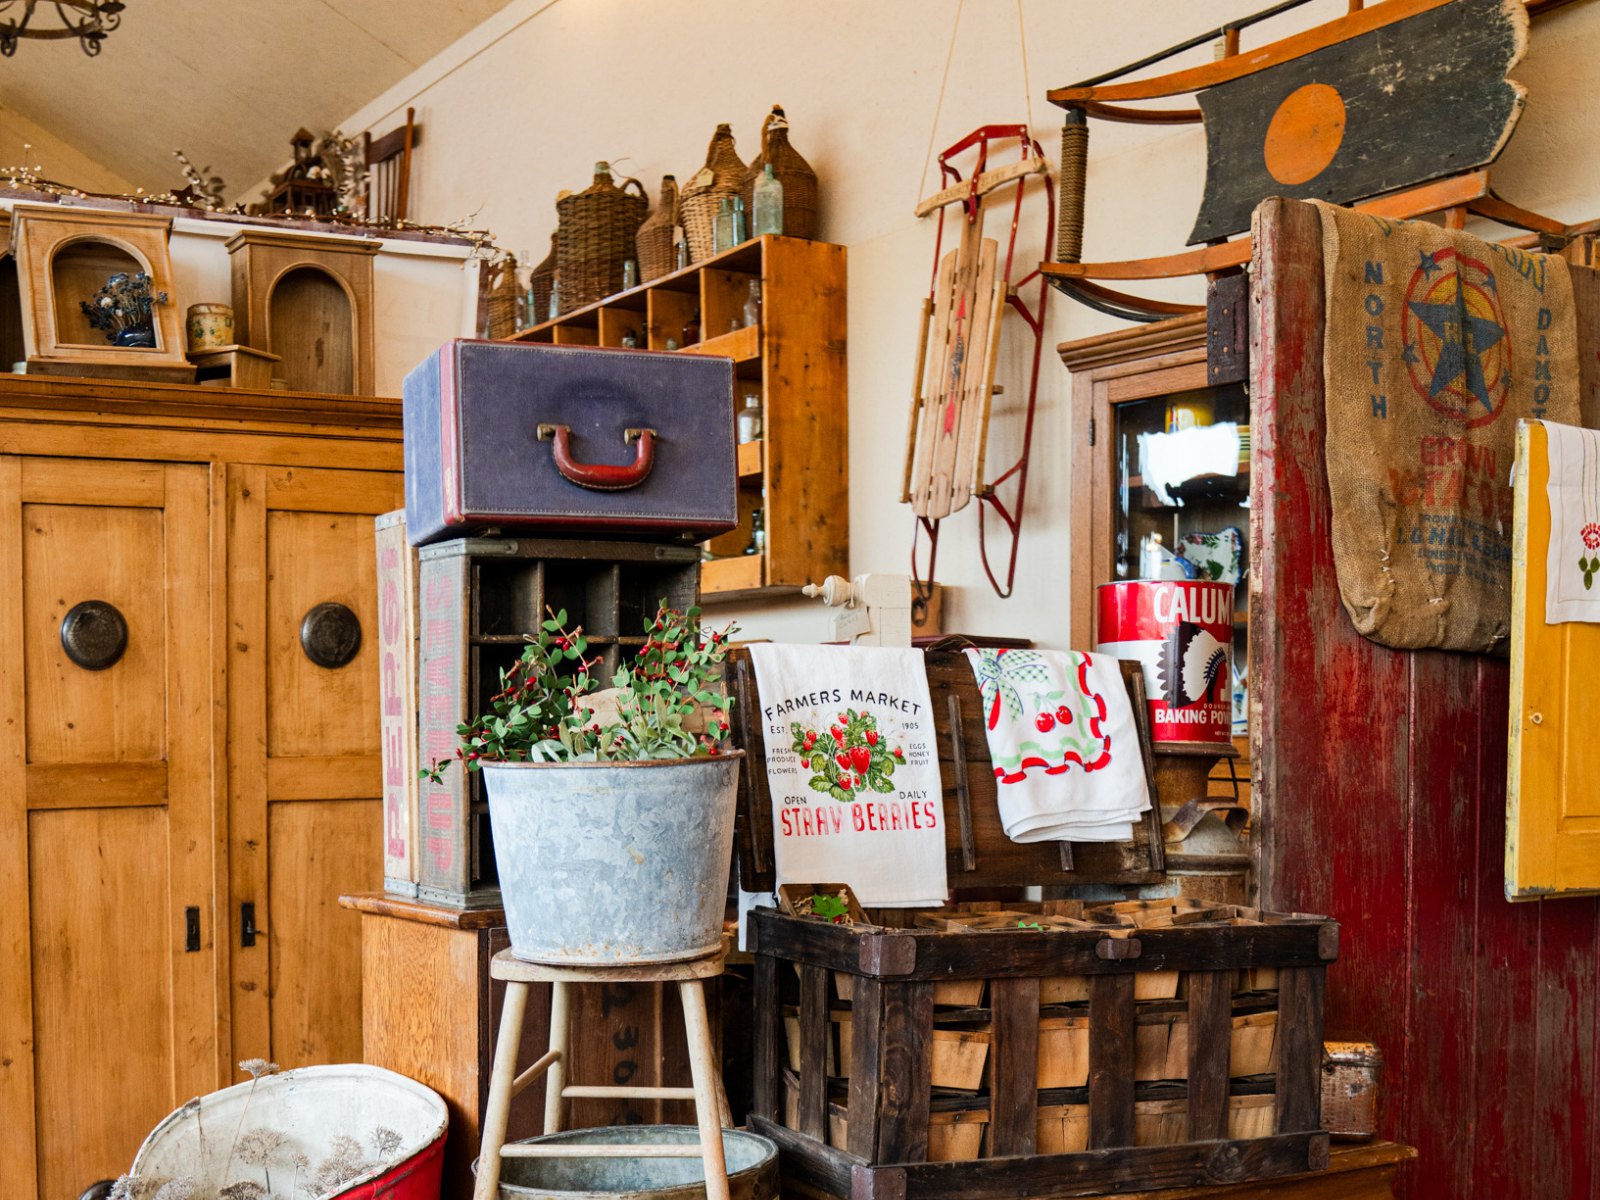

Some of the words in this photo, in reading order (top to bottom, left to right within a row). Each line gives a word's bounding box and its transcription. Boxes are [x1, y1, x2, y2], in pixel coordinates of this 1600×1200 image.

[1364, 260, 1387, 419] NORTH
[1532, 308, 1553, 418] DAKOT
[1153, 585, 1232, 626] CALUM
[426, 575, 453, 765] SEVEN
[382, 547, 405, 859] PEPSI
[765, 689, 842, 722] FARMERS
[850, 689, 922, 716] MARKET
[1155, 709, 1207, 724] BAKING
[1210, 709, 1231, 725] POW
[901, 721, 919, 730] 1905
[784, 796, 807, 805] OPEN
[899, 790, 928, 800] DAILY
[851, 801, 937, 832] BERRIES
[426, 793, 453, 872] UP
